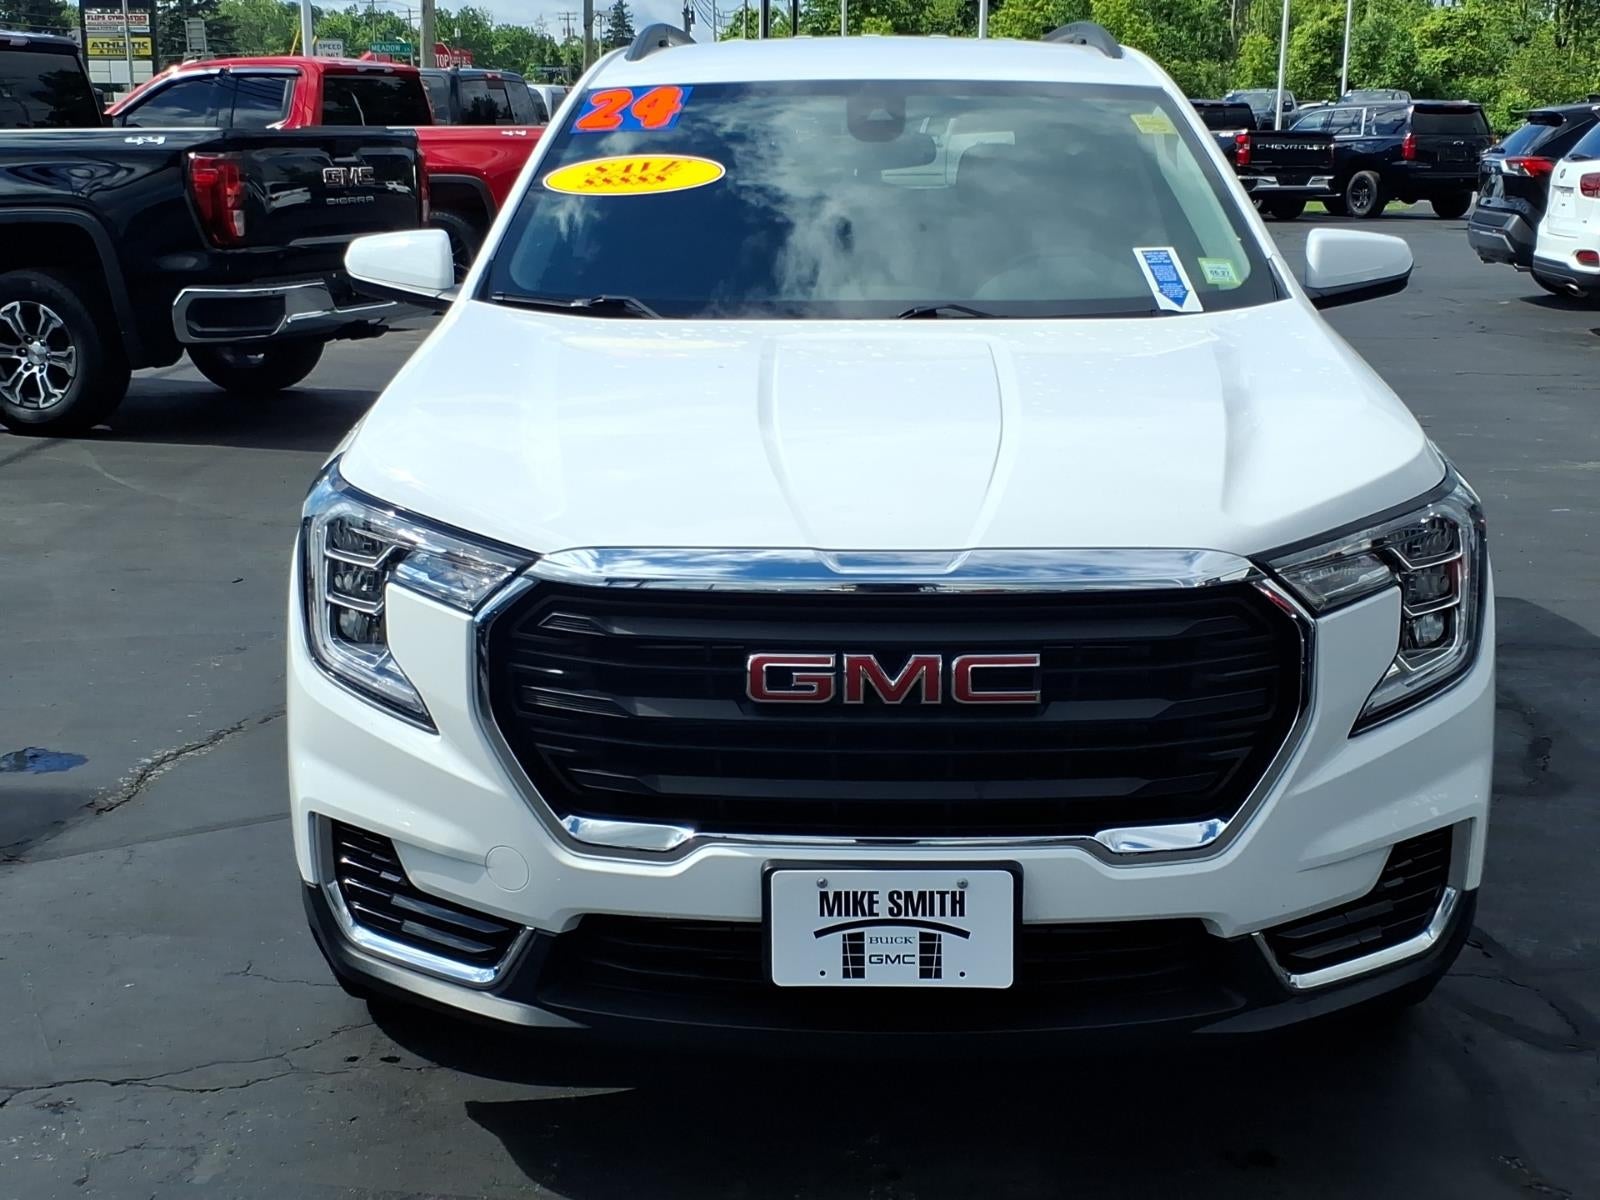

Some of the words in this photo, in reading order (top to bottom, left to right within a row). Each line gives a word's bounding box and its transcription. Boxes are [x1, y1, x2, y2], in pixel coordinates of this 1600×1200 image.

[371, 44, 401, 53] MEADOW
[435, 54, 449, 67] TOP
[576, 85, 683, 131] 24
[1257, 143, 1326, 151] CHEVROLET
[322, 166, 376, 187] GMC
[326, 195, 375, 205] SIERRA
[746, 652, 1042, 705] GMC
[818, 890, 880, 918] MIKE
[887, 889, 966, 918] SMITH
[868, 936, 914, 945] BUICK
[868, 953, 916, 965] GMC
